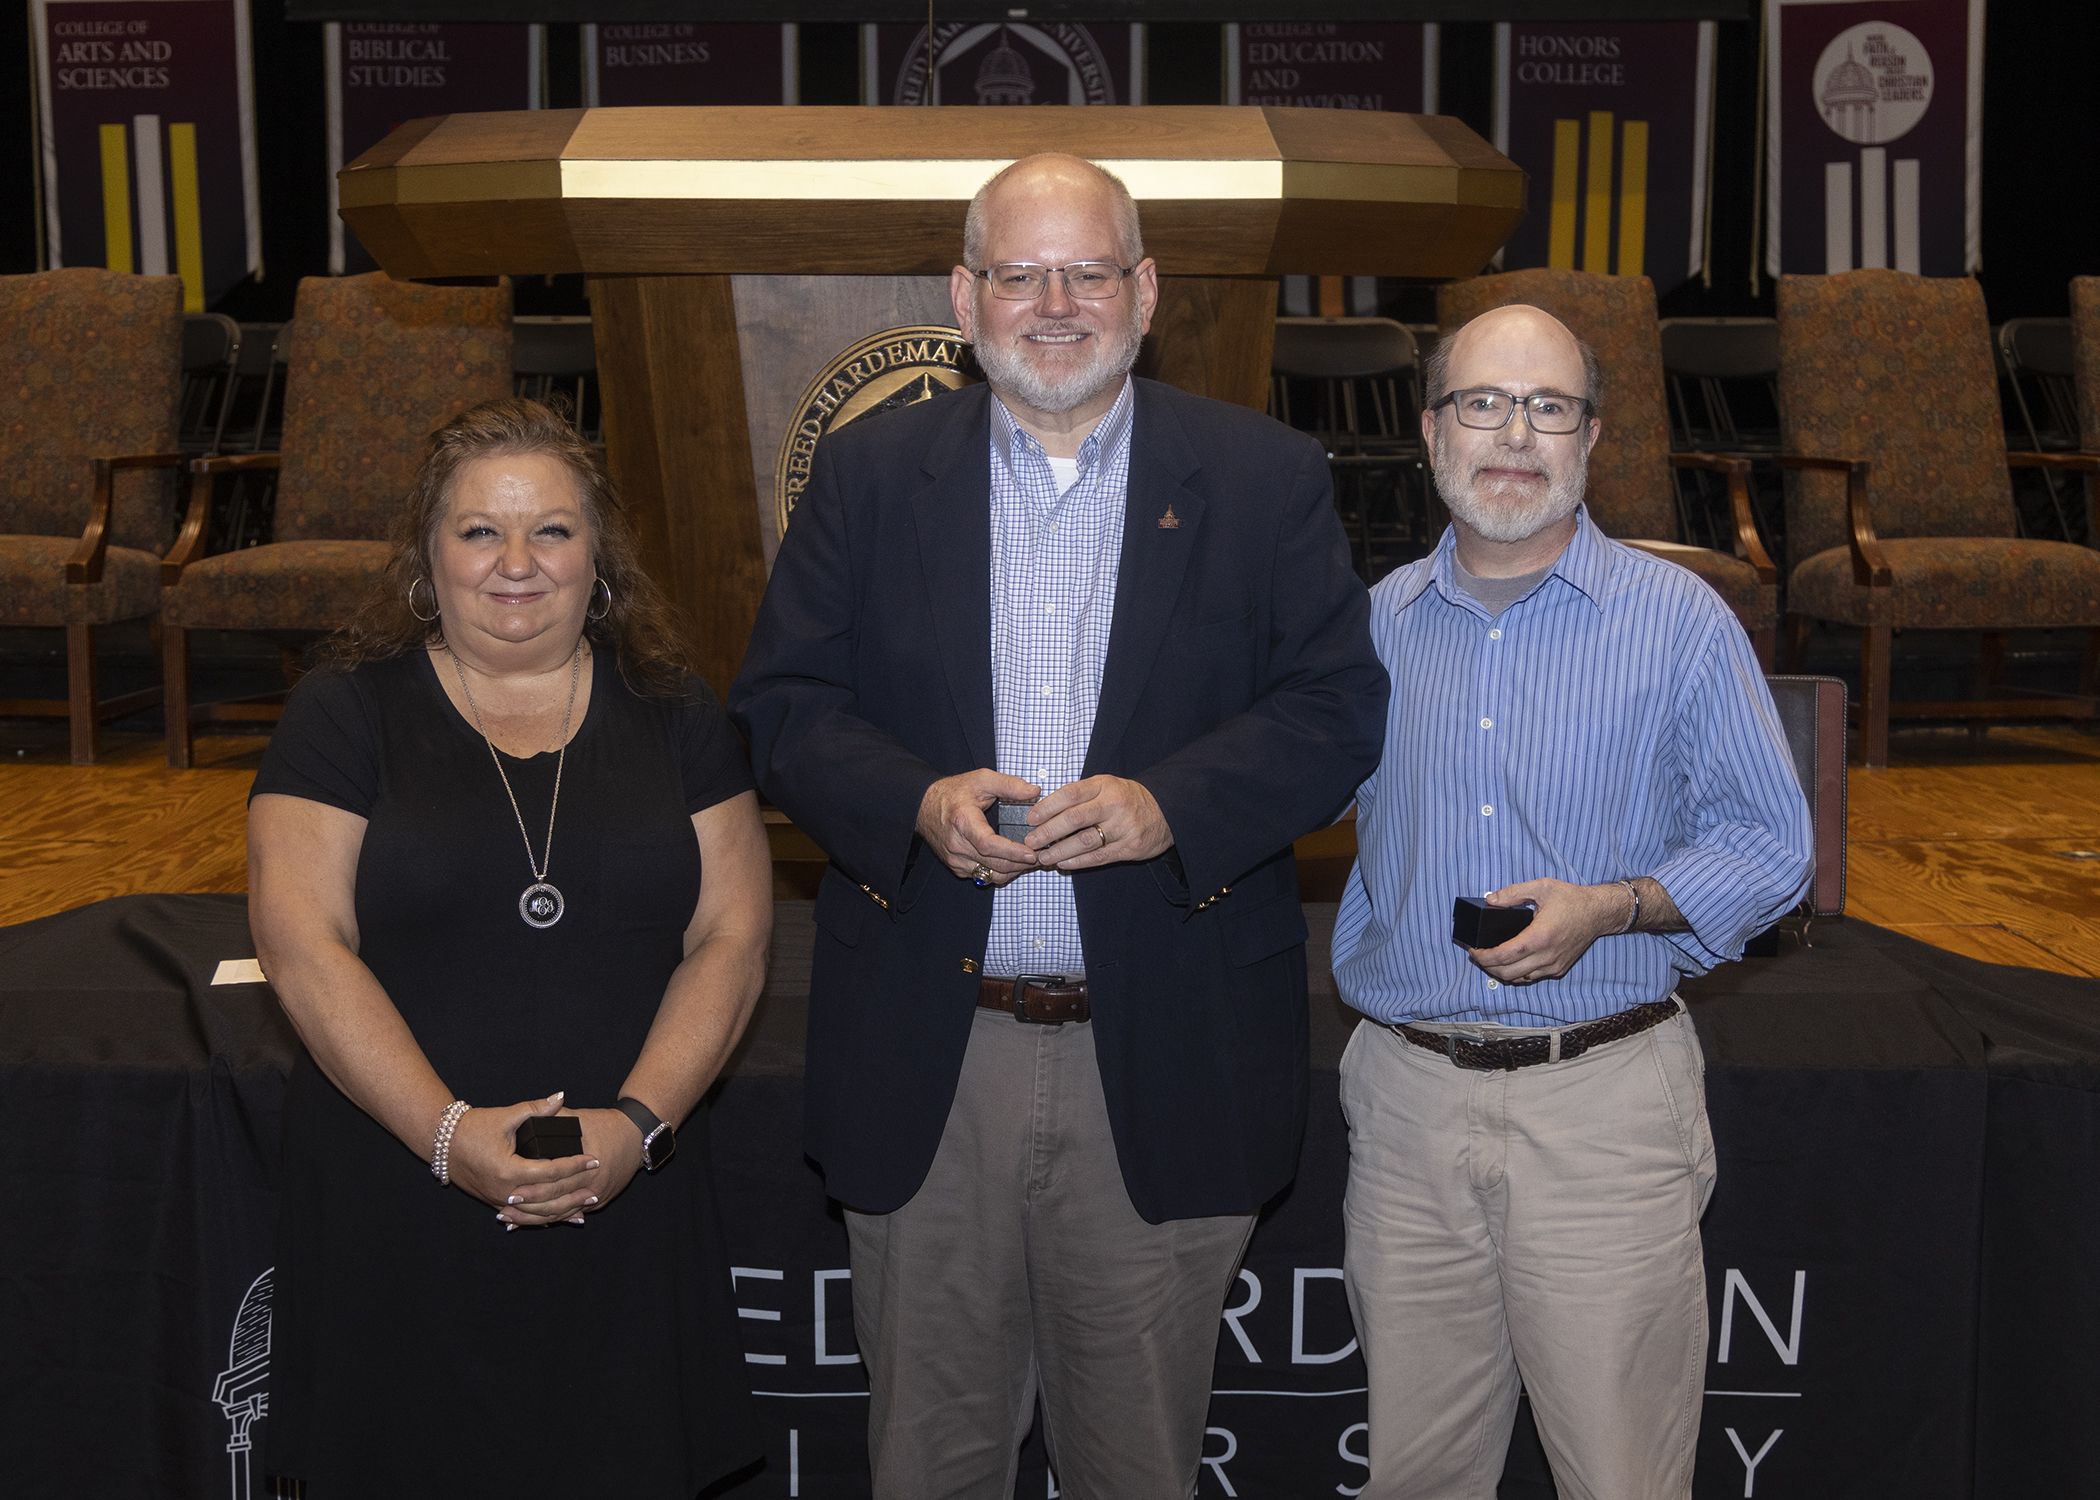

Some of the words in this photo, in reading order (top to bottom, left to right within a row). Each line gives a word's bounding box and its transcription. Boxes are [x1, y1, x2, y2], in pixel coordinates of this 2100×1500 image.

[54, 20, 126, 36] COLLEGE
[127, 20, 149, 35] OF
[603, 24, 671, 39] COLLEGE
[1246, 22, 1312, 37] COLLEGE
[1316, 22, 1336, 36] OF
[57, 41, 115, 62] ARTS
[119, 40, 172, 62] AND
[348, 40, 451, 61] BIBLICAL
[606, 41, 710, 67] BUSINESS
[1248, 41, 1384, 63] EDUCATION
[1519, 35, 1620, 59] HONORS
[58, 67, 170, 90] SCIENCES
[348, 65, 447, 87] STUDIES
[1248, 69, 1300, 90] AND
[1517, 61, 1625, 86] COLLEGE
